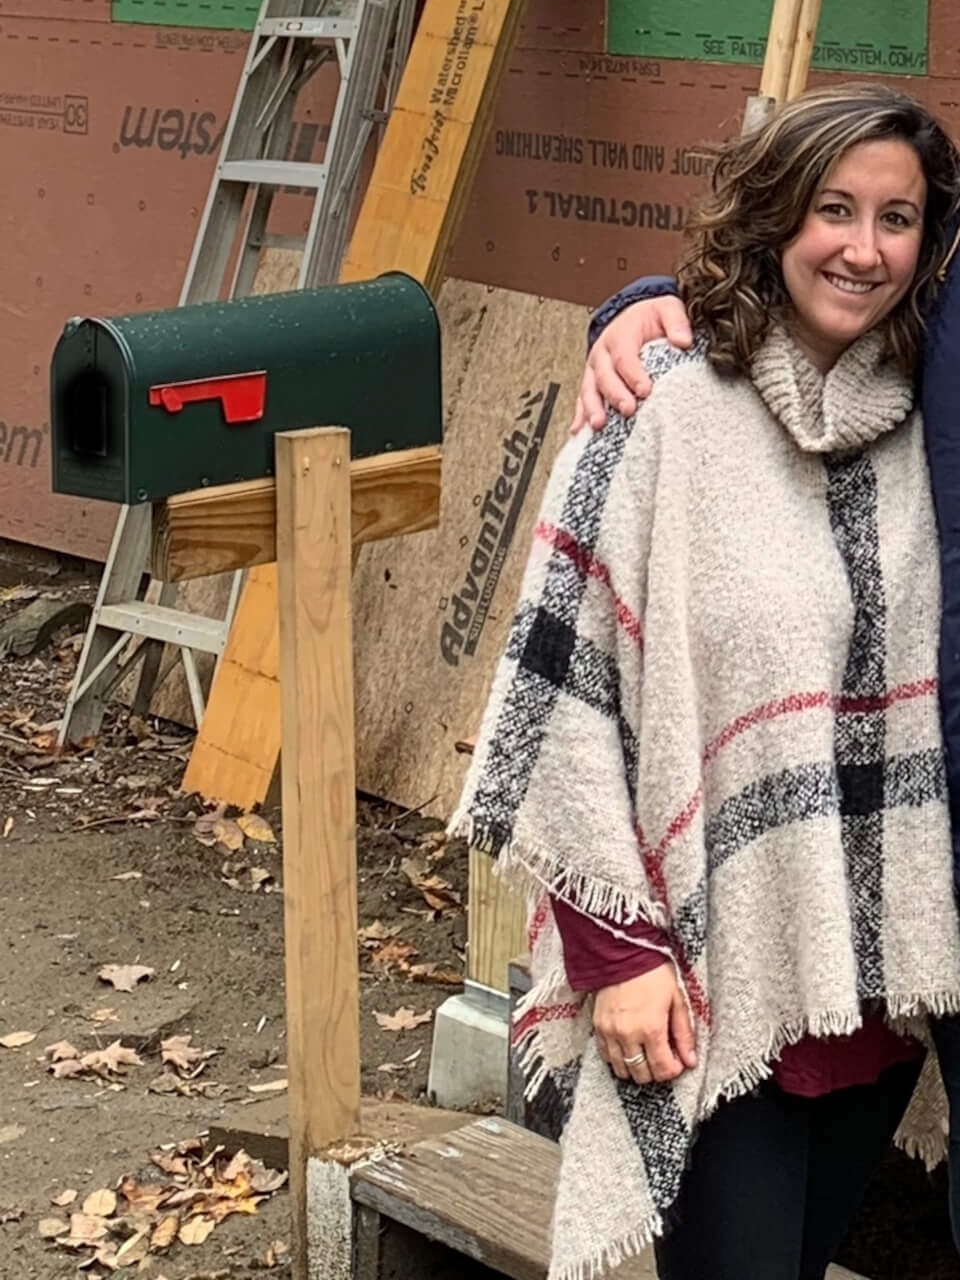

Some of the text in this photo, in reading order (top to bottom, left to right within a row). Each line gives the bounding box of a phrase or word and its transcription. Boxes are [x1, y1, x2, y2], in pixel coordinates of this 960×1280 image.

[703, 39, 726, 56] SEE
[495, 129, 584, 164] SHEATHING
[587, 139, 628, 170] WALL
[632, 143, 665, 171] AND
